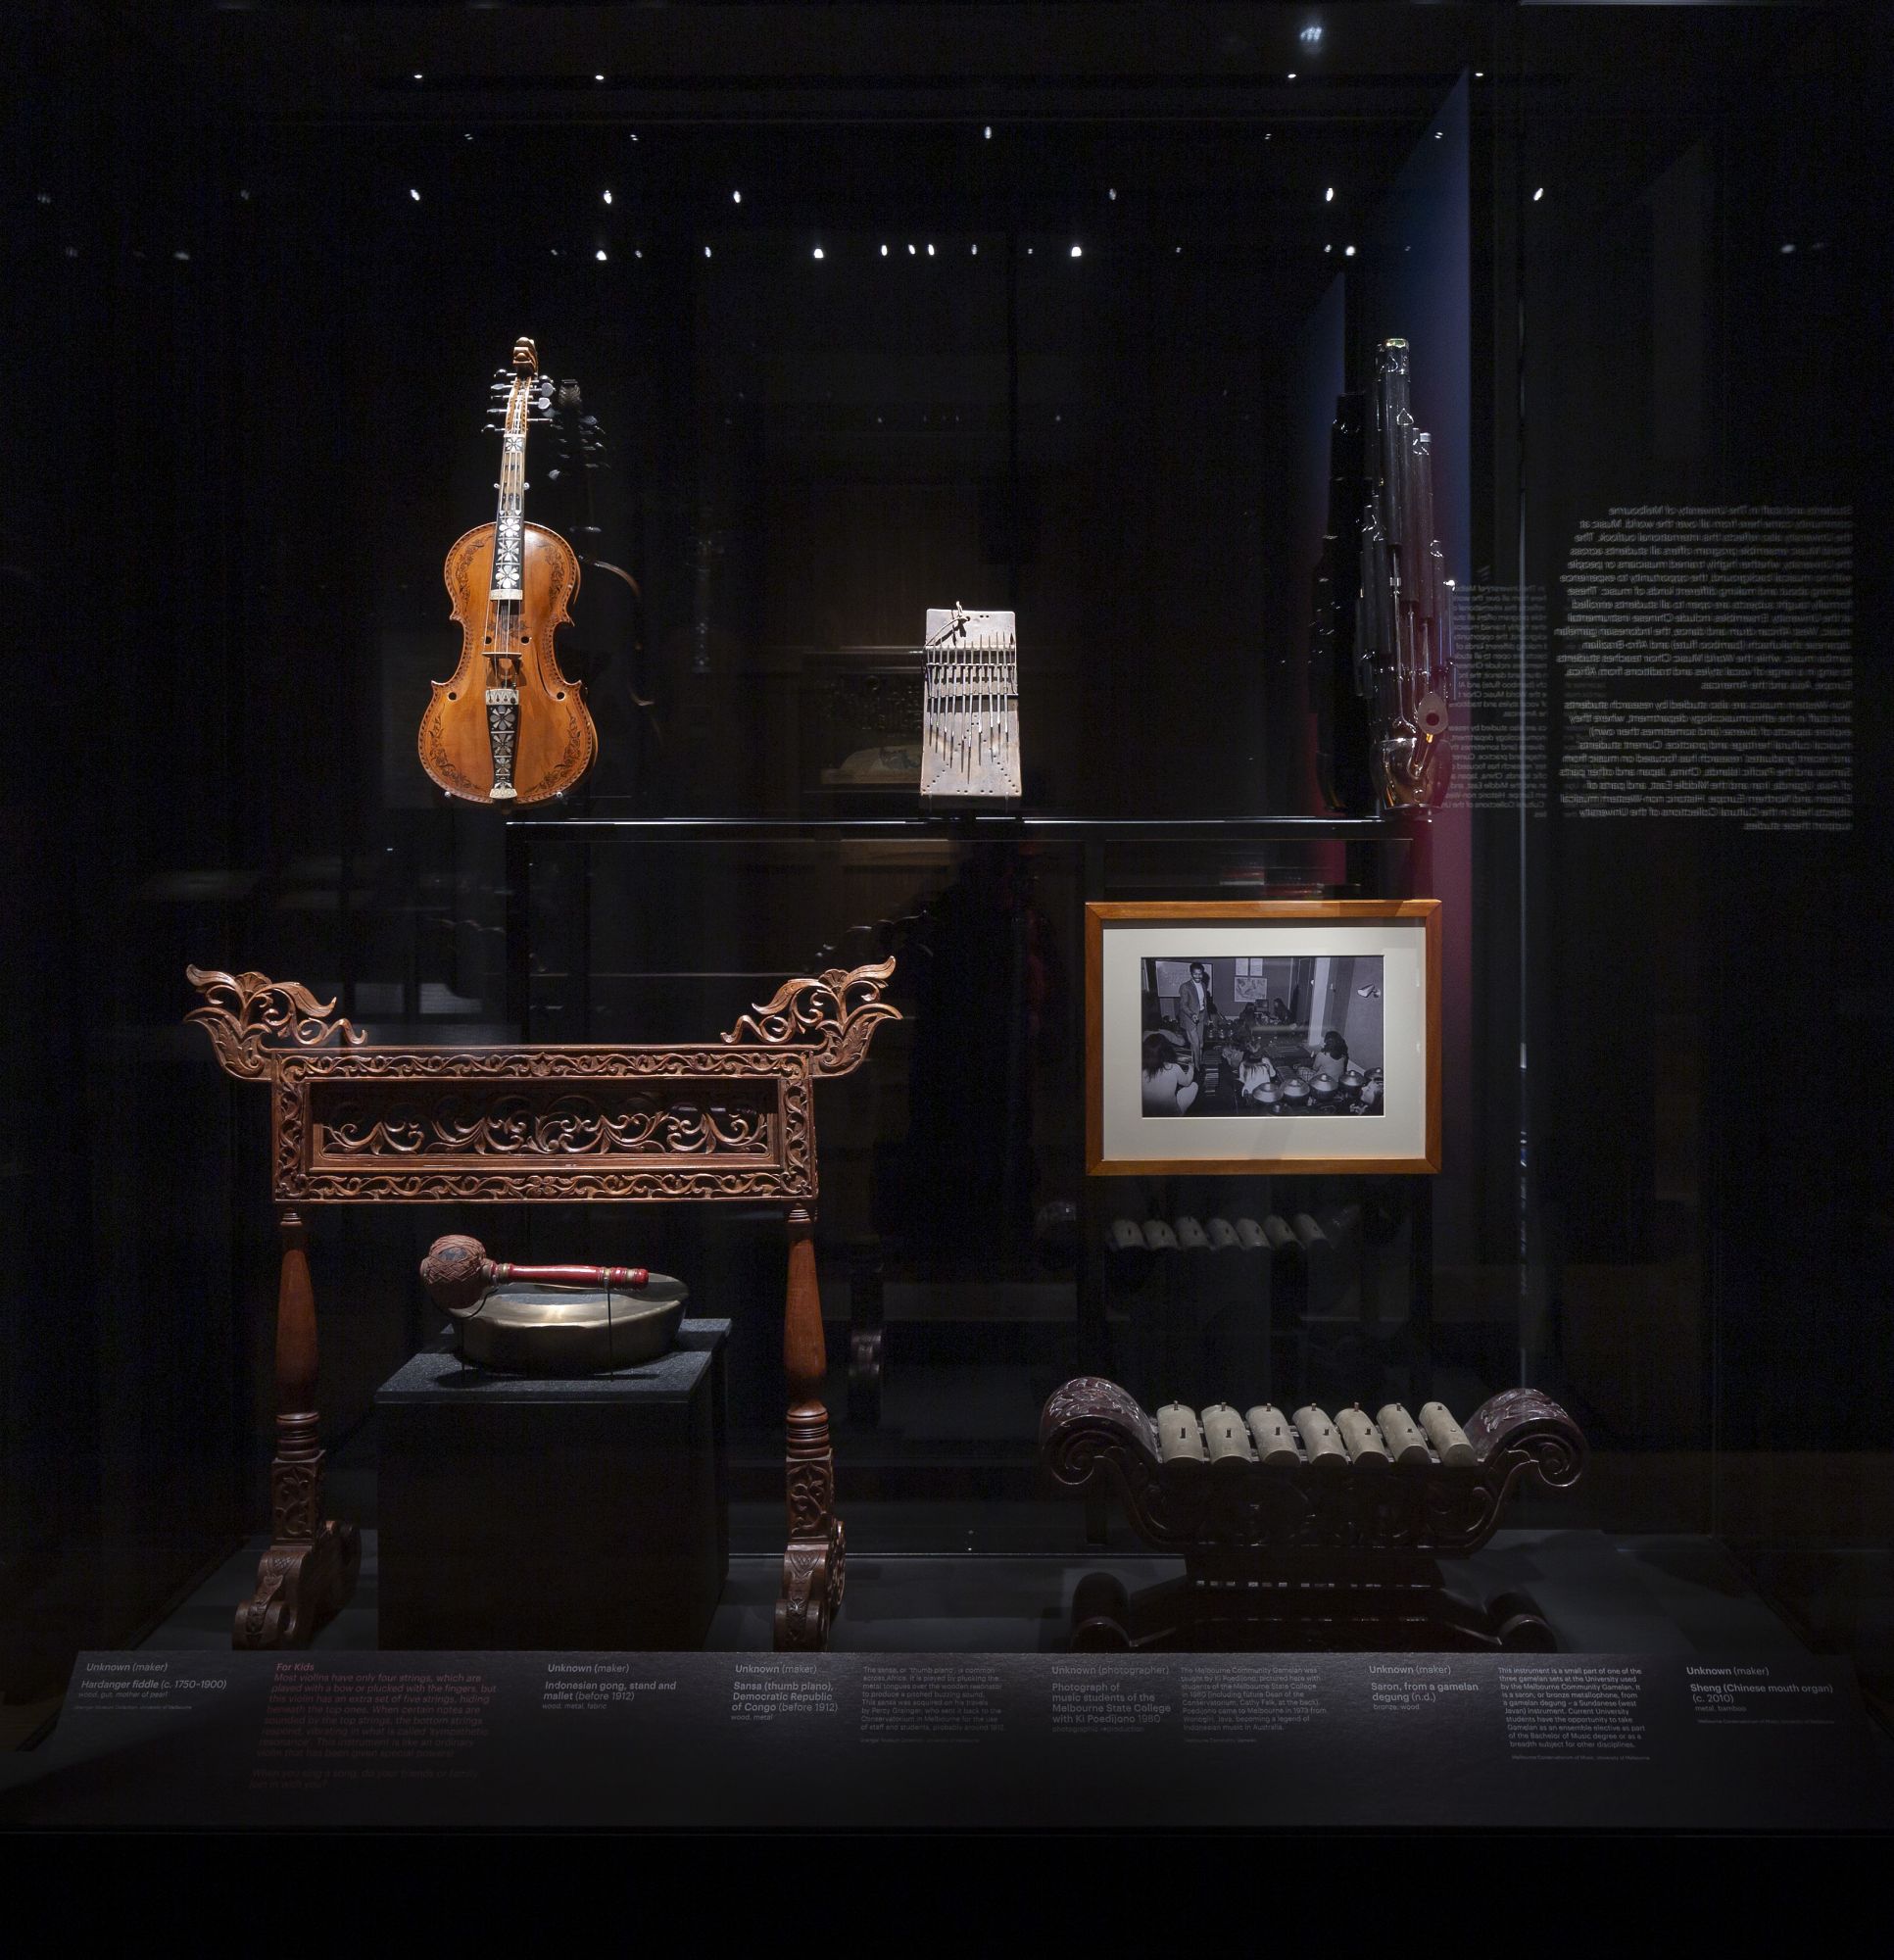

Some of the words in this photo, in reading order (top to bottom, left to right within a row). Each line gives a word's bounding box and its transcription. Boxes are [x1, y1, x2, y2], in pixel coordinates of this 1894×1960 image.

[131, 1663, 168, 1672] (maker)
[548, 1664, 592, 1673] Unknown
[593, 1664, 630, 1673] (maker)
[780, 1665, 817, 1674] (maker)
[1051, 1666, 1095, 1675] Unknown
[1097, 1666, 1169, 1677] (photographer)
[1731, 1667, 1770, 1676] (maker)
[355, 1674, 375, 1684] only
[399, 1674, 434, 1684] strings,
[81, 1680, 132, 1690] Hardanger
[133, 1680, 160, 1689] fiddle
[162, 1680, 173, 1690] (c.
[545, 1681, 598, 1690] Indonesian
[599, 1684, 627, 1692] gong,
[628, 1681, 656, 1690] stand
[657, 1681, 676, 1690] and
[733, 1682, 762, 1690] Sansa
[763, 1682, 798, 1691] (thumb
[800, 1682, 833, 1692] piano),
[1052, 1683, 1107, 1693] Photograph
[1109, 1683, 1120, 1691] of
[1371, 1683, 1402, 1691] Saron,
[1437, 1683, 1479, 1692] gamelan
[1690, 1685, 1722, 1694] Sheng
[1723, 1685, 1765, 1693] (Chinese
[1800, 1685, 1833, 1694] organ)
[575, 1692, 610, 1701] (before
[611, 1692, 634, 1701] 1912)
[733, 1692, 790, 1701] Democratic
[791, 1692, 832, 1703] Republic
[1372, 1693, 1409, 1702] degung
[1692, 1694, 1705, 1703] (c.
[1706, 1694, 1733, 1703] 2010)
[744, 1703, 776, 1713] Congo
[777, 1703, 813, 1712] (before
[815, 1703, 839, 1712] 1912)
[1134, 1704, 1171, 1714] College
[1087, 1715, 1136, 1725] Poedijono
